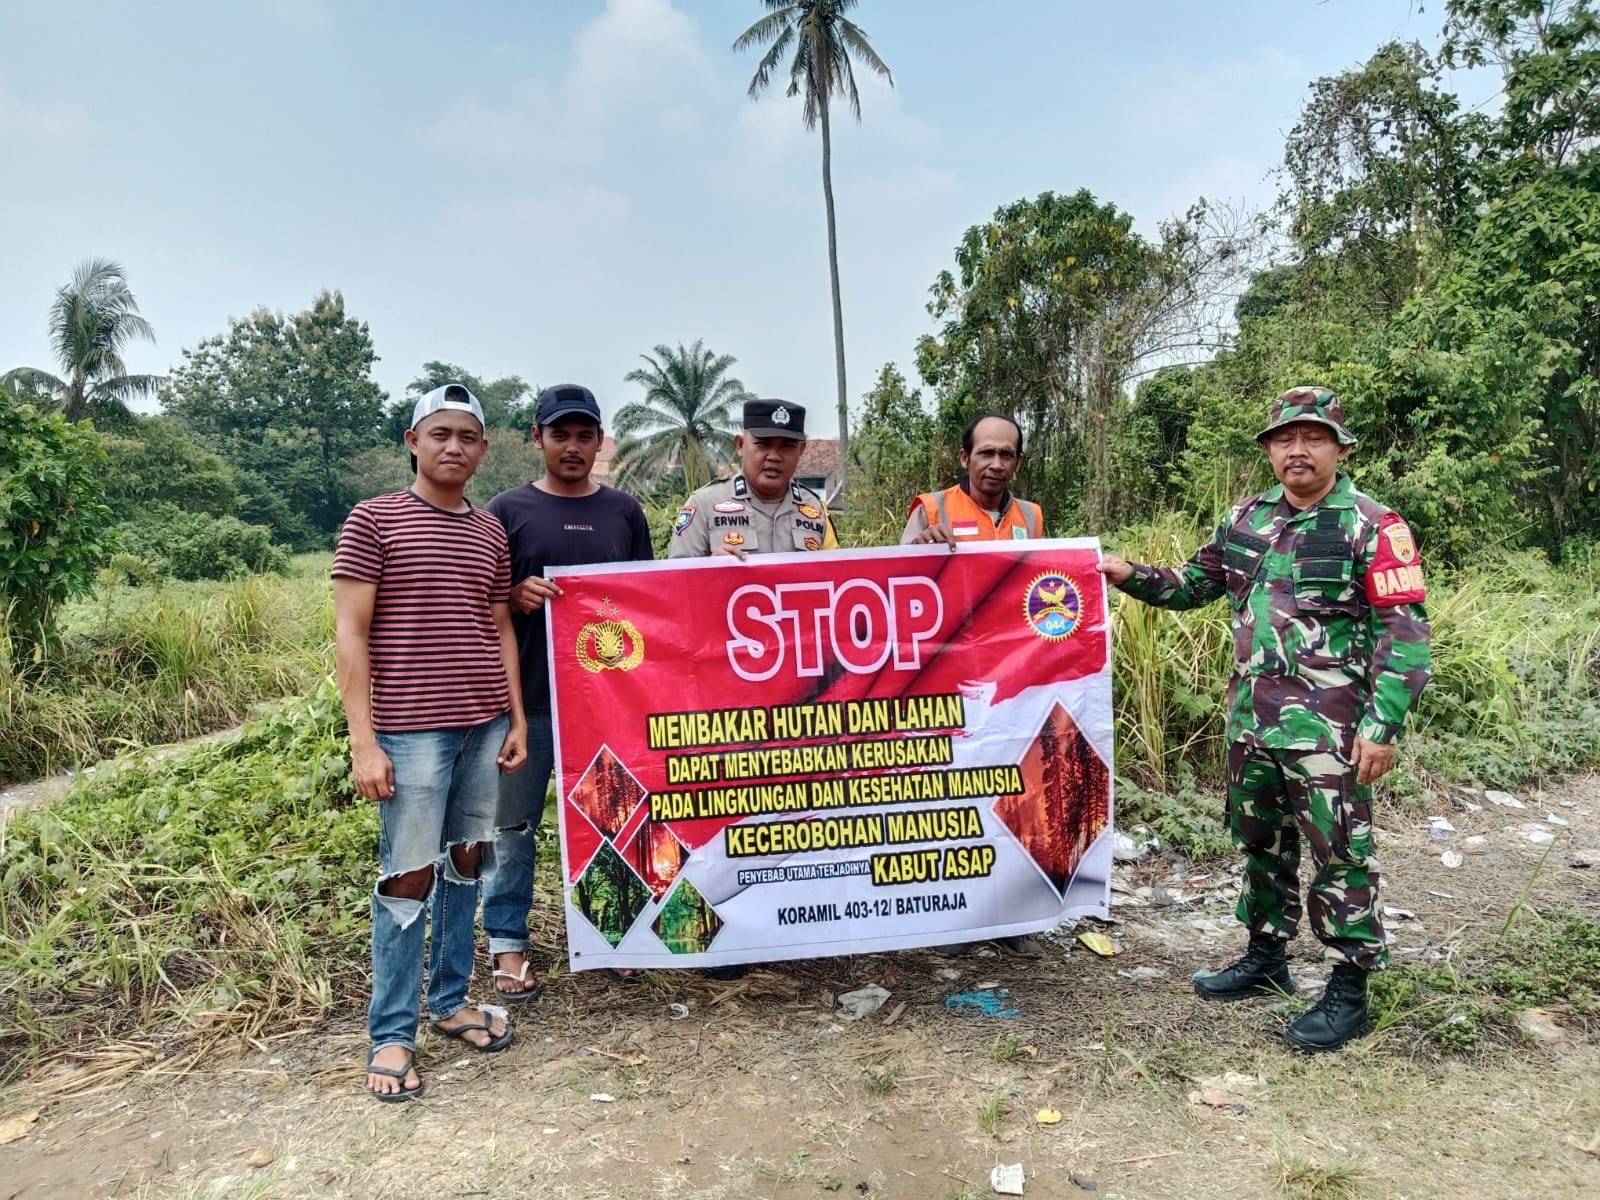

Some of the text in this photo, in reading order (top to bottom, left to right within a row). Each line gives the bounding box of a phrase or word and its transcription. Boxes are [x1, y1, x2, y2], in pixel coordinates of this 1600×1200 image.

[714, 515, 749, 527] ERWIN
[726, 576, 944, 682] STOP
[1045, 619, 1066, 631] 044
[648, 695, 963, 749] MEMBAKAR HUTAN DAN LAHAN
[668, 737, 951, 783] DAPAT MENYEBABKAN KERUSAKAN
[651, 767, 1023, 821] PADA LINGKUNGAN DAN KESEHATAN MANUSIA
[727, 809, 982, 856] KECEROBOHAN MANUSIA
[739, 847, 994, 884] PENYEBAB UTAMA TERJADINYA KABUT ASAP
[777, 892, 968, 926] KORAMIL 403-12/ BATURAJA
